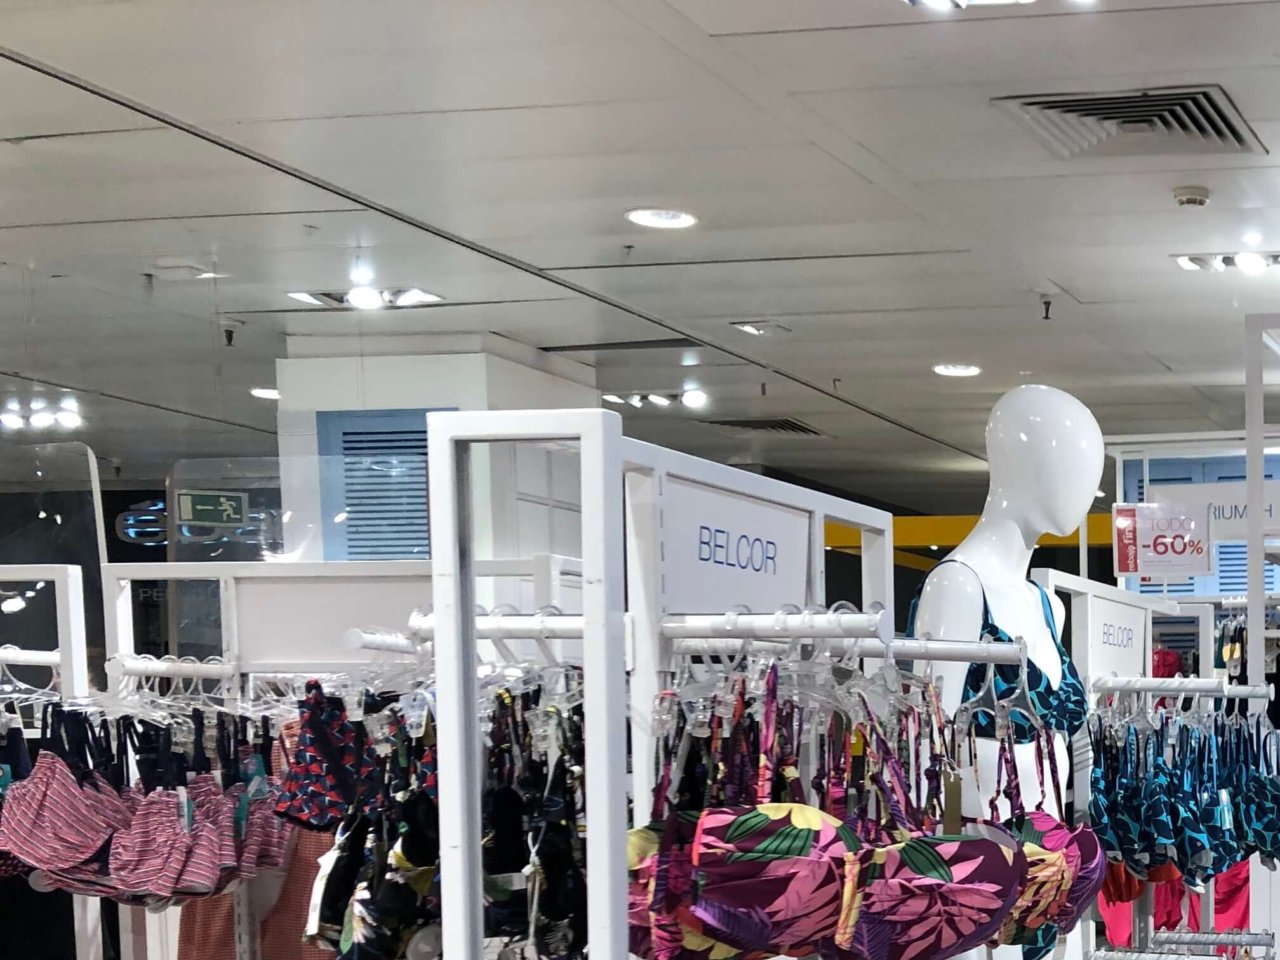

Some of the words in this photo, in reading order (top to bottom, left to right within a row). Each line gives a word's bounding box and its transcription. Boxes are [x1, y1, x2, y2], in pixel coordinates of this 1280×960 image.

[1150, 517, 1197, 532] TODO
[699, 525, 777, 575] BELCOR
[1141, 534, 1203, 555] -60%
[1102, 623, 1134, 648] BELCOR
